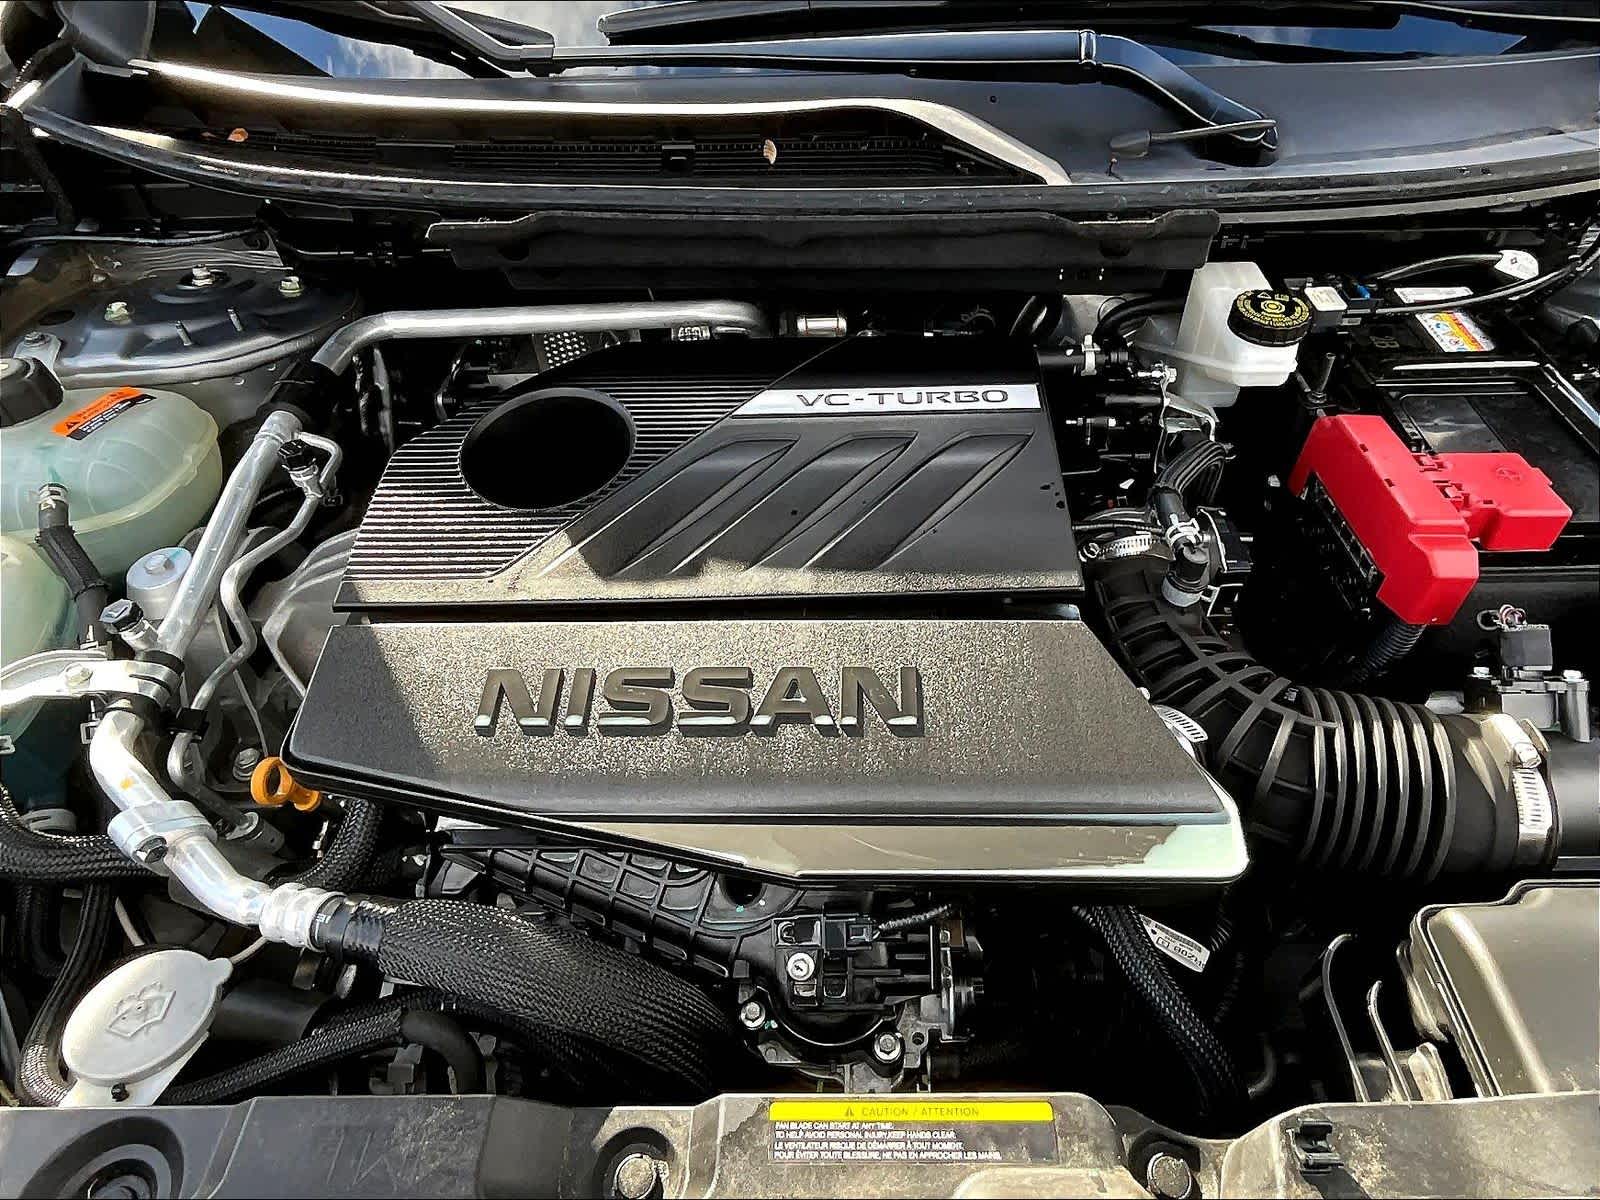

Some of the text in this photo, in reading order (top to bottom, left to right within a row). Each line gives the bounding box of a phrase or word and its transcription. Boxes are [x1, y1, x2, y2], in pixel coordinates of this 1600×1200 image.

[796, 389, 1009, 407] VC-TURBO
[474, 666, 924, 736] NISSAN
[861, 1106, 909, 1117] CAUTION
[921, 1106, 980, 1117] ATTENTION
